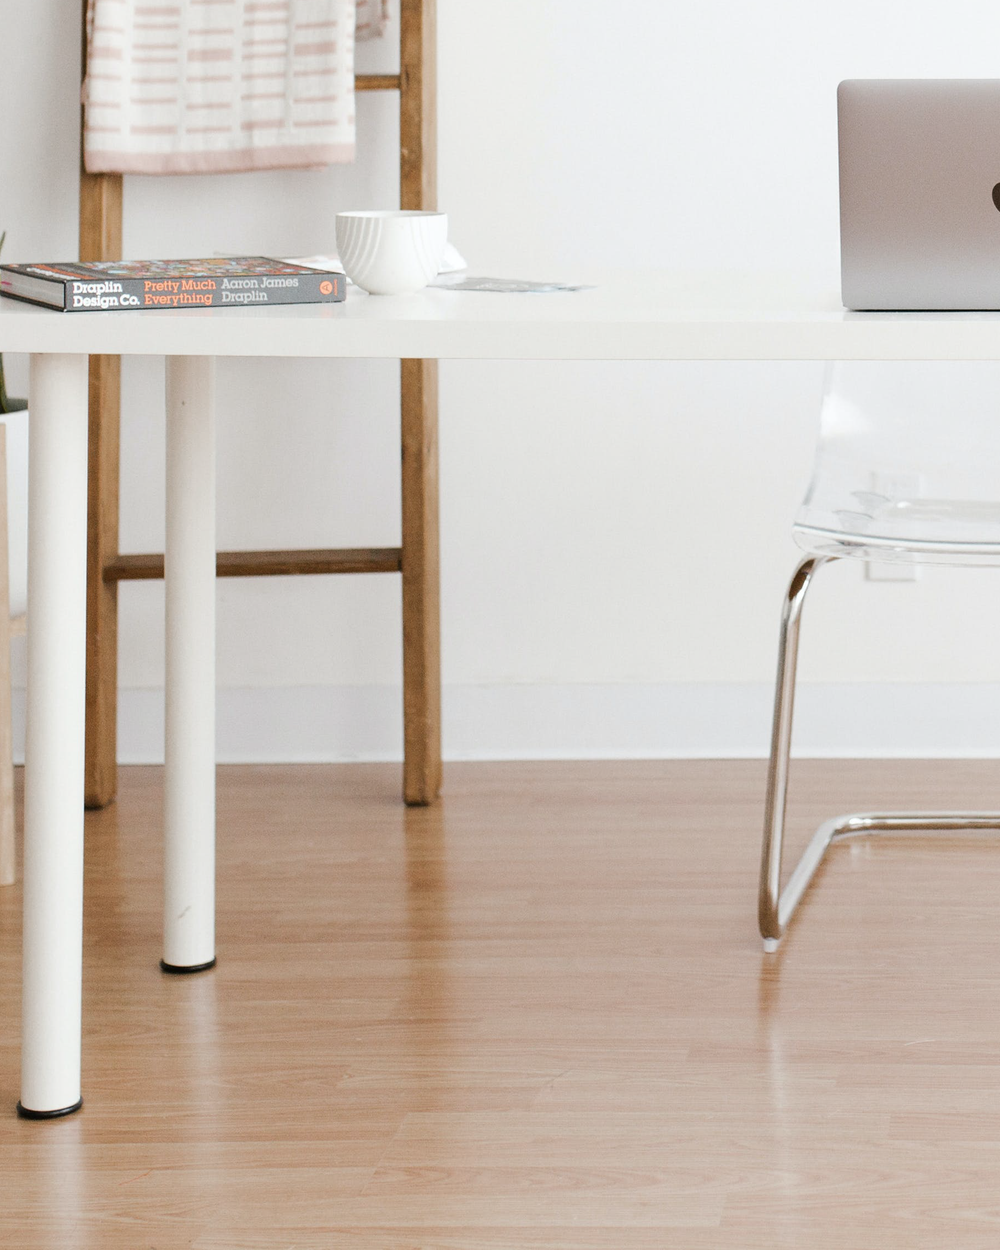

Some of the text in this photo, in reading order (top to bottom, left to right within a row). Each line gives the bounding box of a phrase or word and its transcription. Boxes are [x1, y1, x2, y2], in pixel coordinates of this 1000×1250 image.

[73, 281, 122, 295] Draplin
[144, 280, 216, 293] Pretty Much
[221, 277, 299, 289] Aaron James
[73, 294, 140, 308] Design Co.
[144, 293, 213, 306] Everything
[222, 291, 268, 303] Draplin
